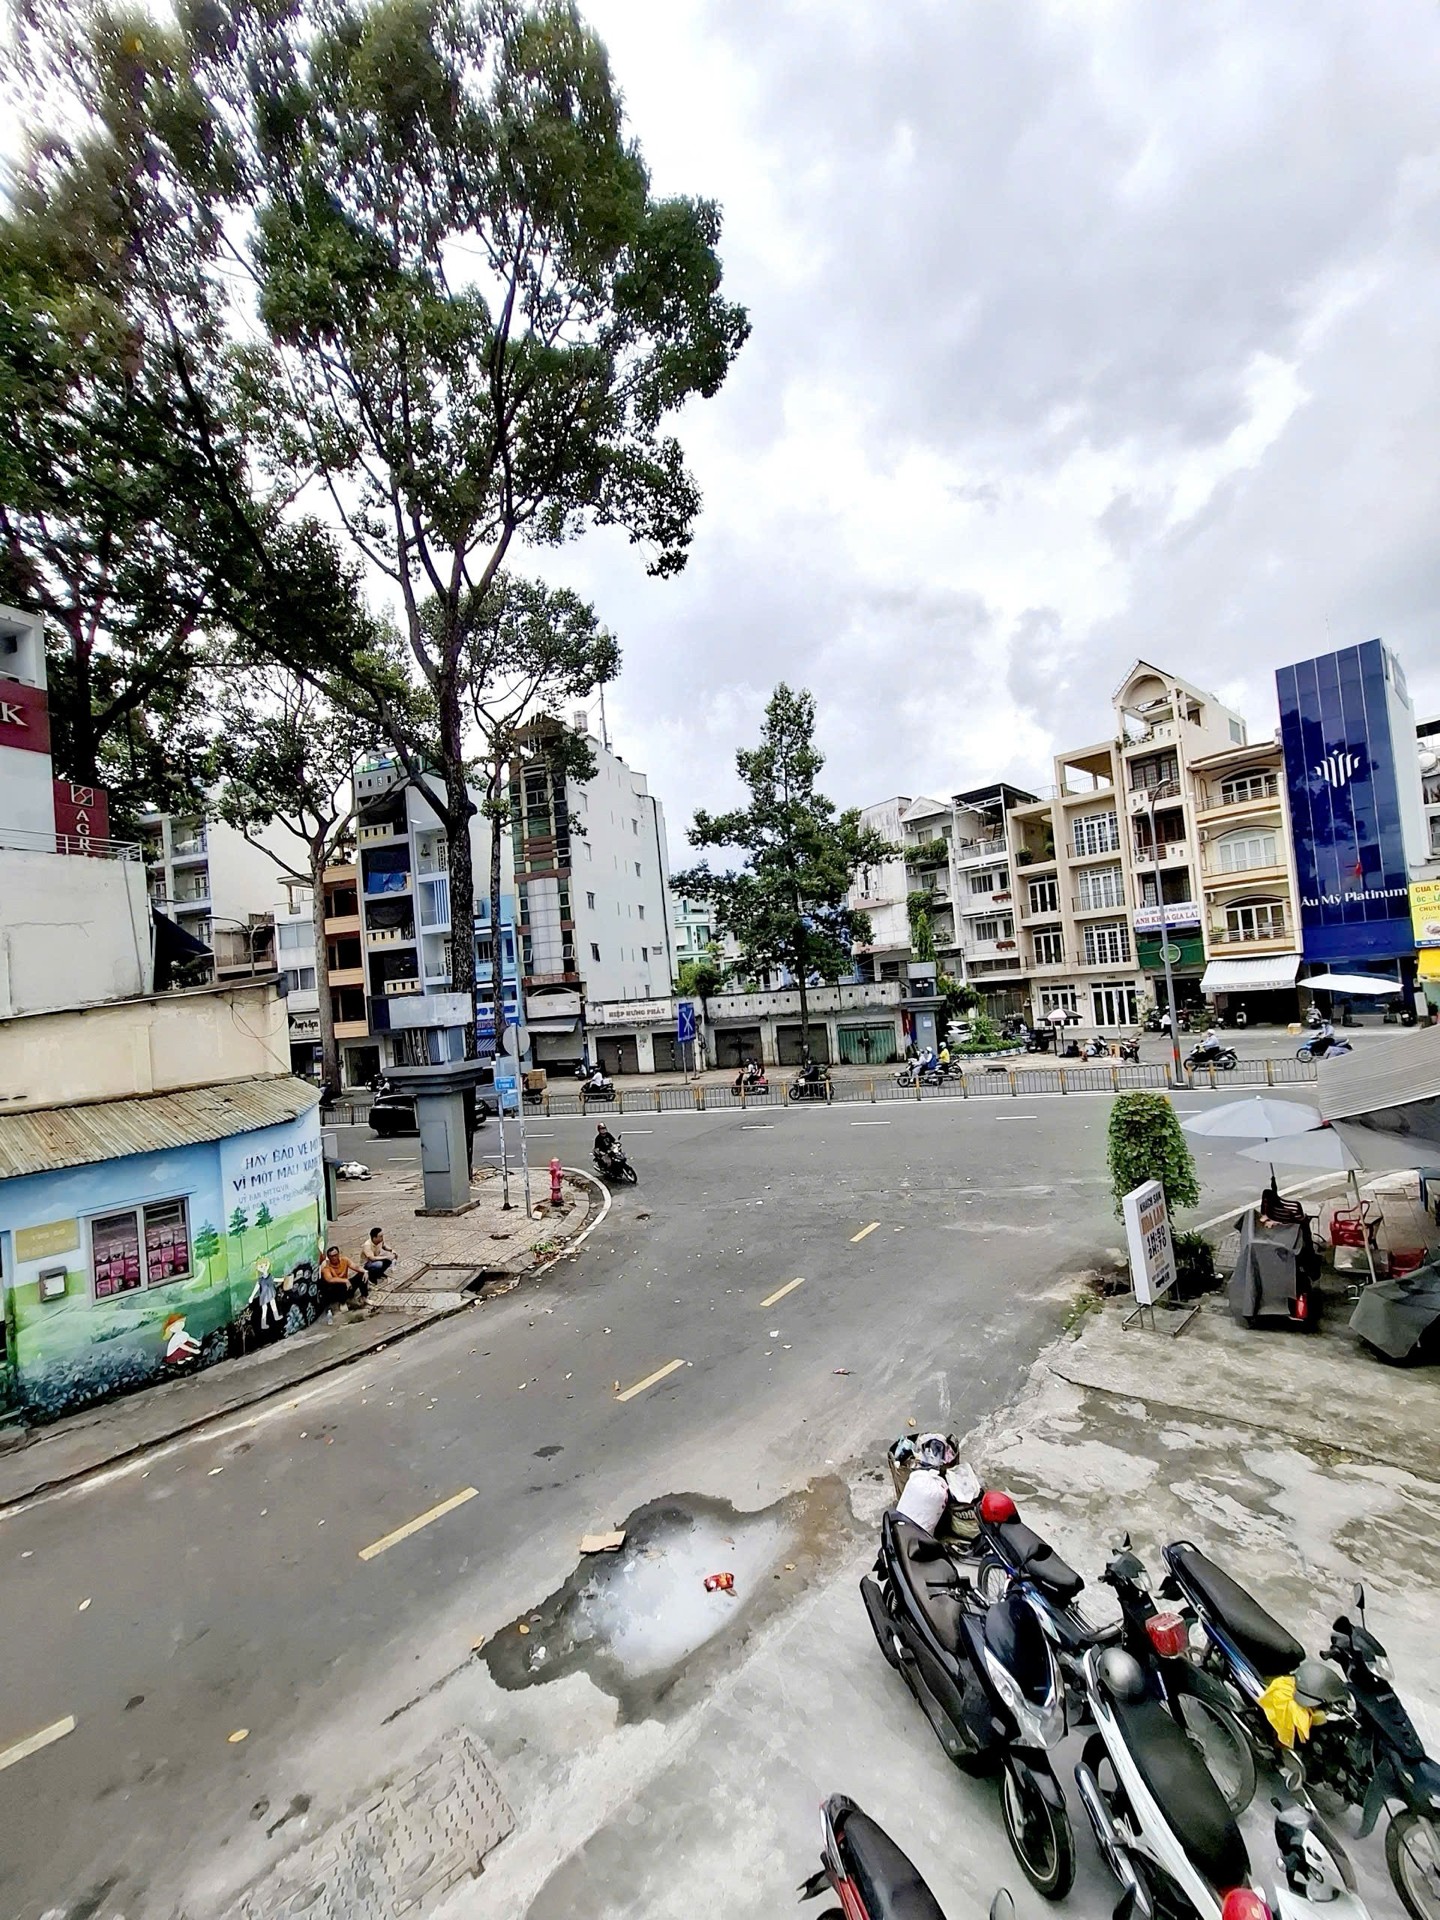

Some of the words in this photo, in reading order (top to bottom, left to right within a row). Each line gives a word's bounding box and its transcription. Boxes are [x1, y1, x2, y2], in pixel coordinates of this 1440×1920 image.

[1301, 895, 1319, 907] Âu
[1345, 887, 1408, 902] Platinum
[1136, 916, 1150, 925] ANH
[1151, 914, 1170, 923] KHA
[1171, 912, 1184, 921] GIA
[1186, 910, 1198, 919] LAI
